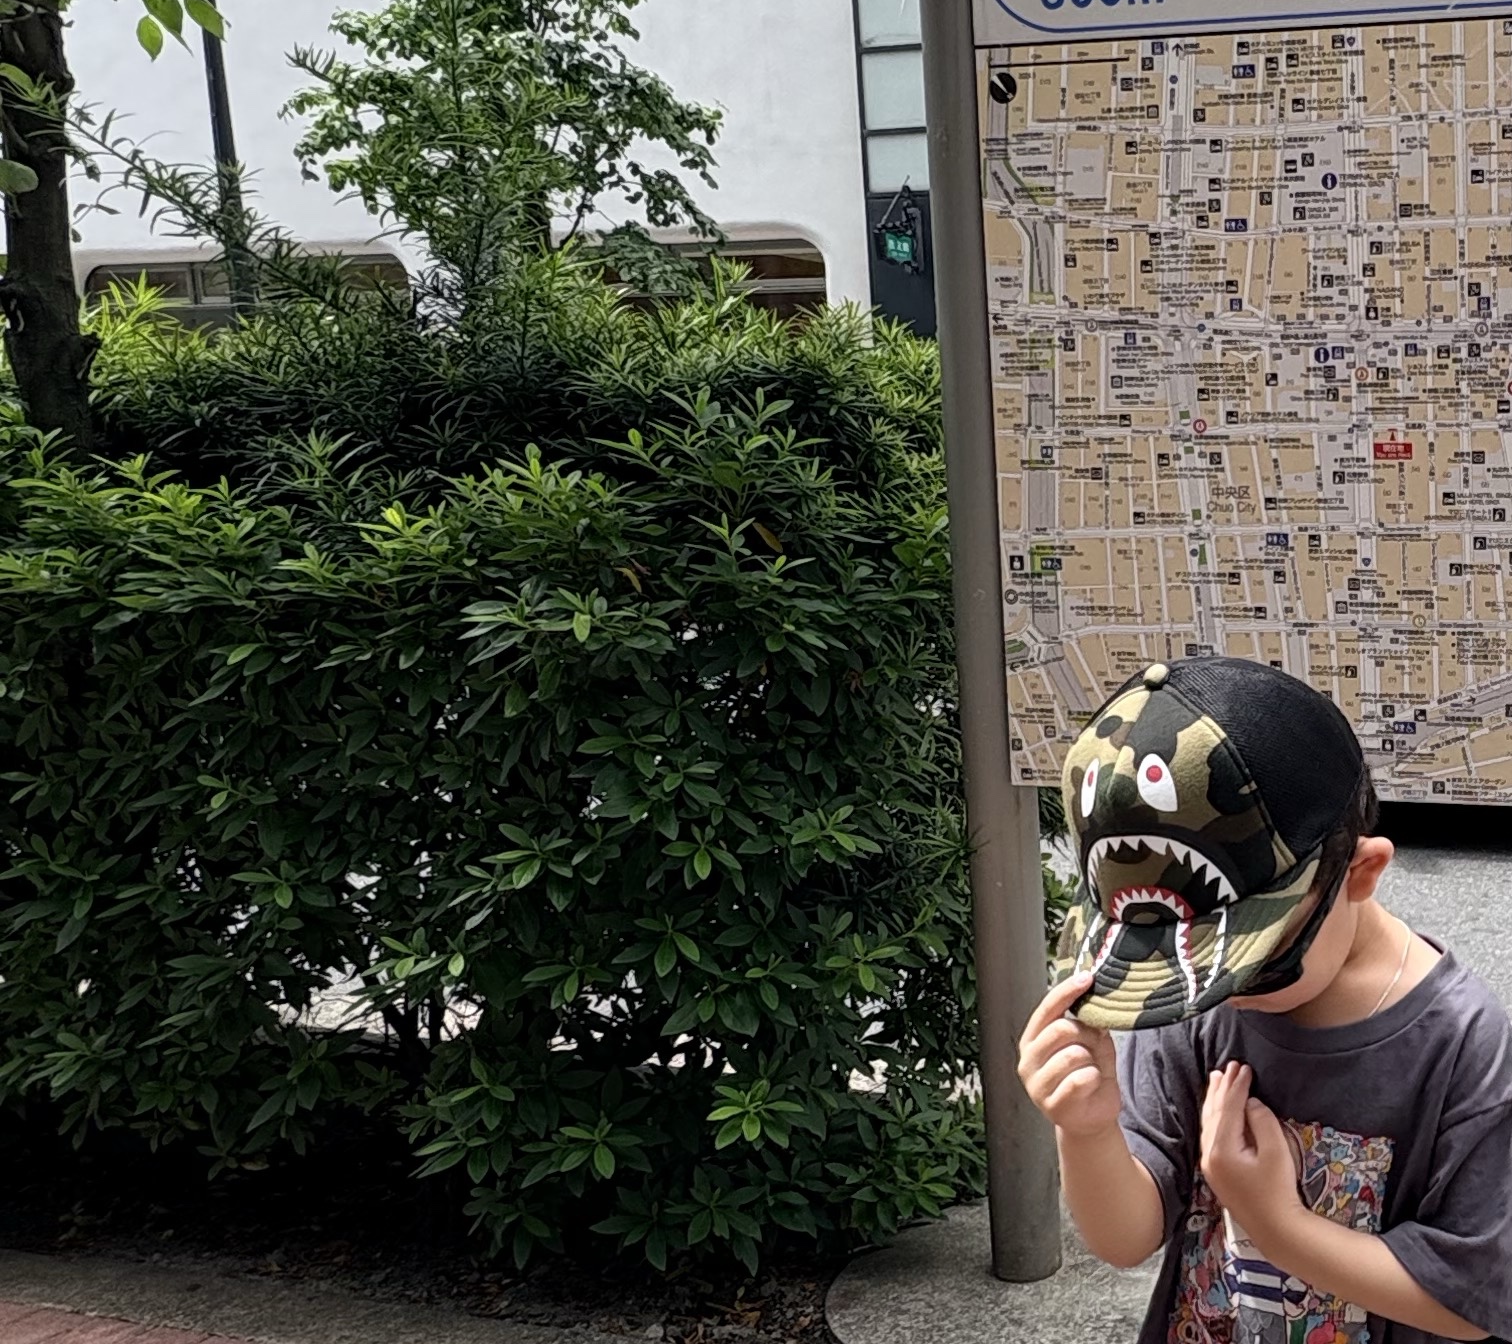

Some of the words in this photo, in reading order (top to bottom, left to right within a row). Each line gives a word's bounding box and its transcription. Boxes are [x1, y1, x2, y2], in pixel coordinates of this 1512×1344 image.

[1211, 481, 1251, 500] 中央区
[1206, 500, 1234, 514] Chuo
